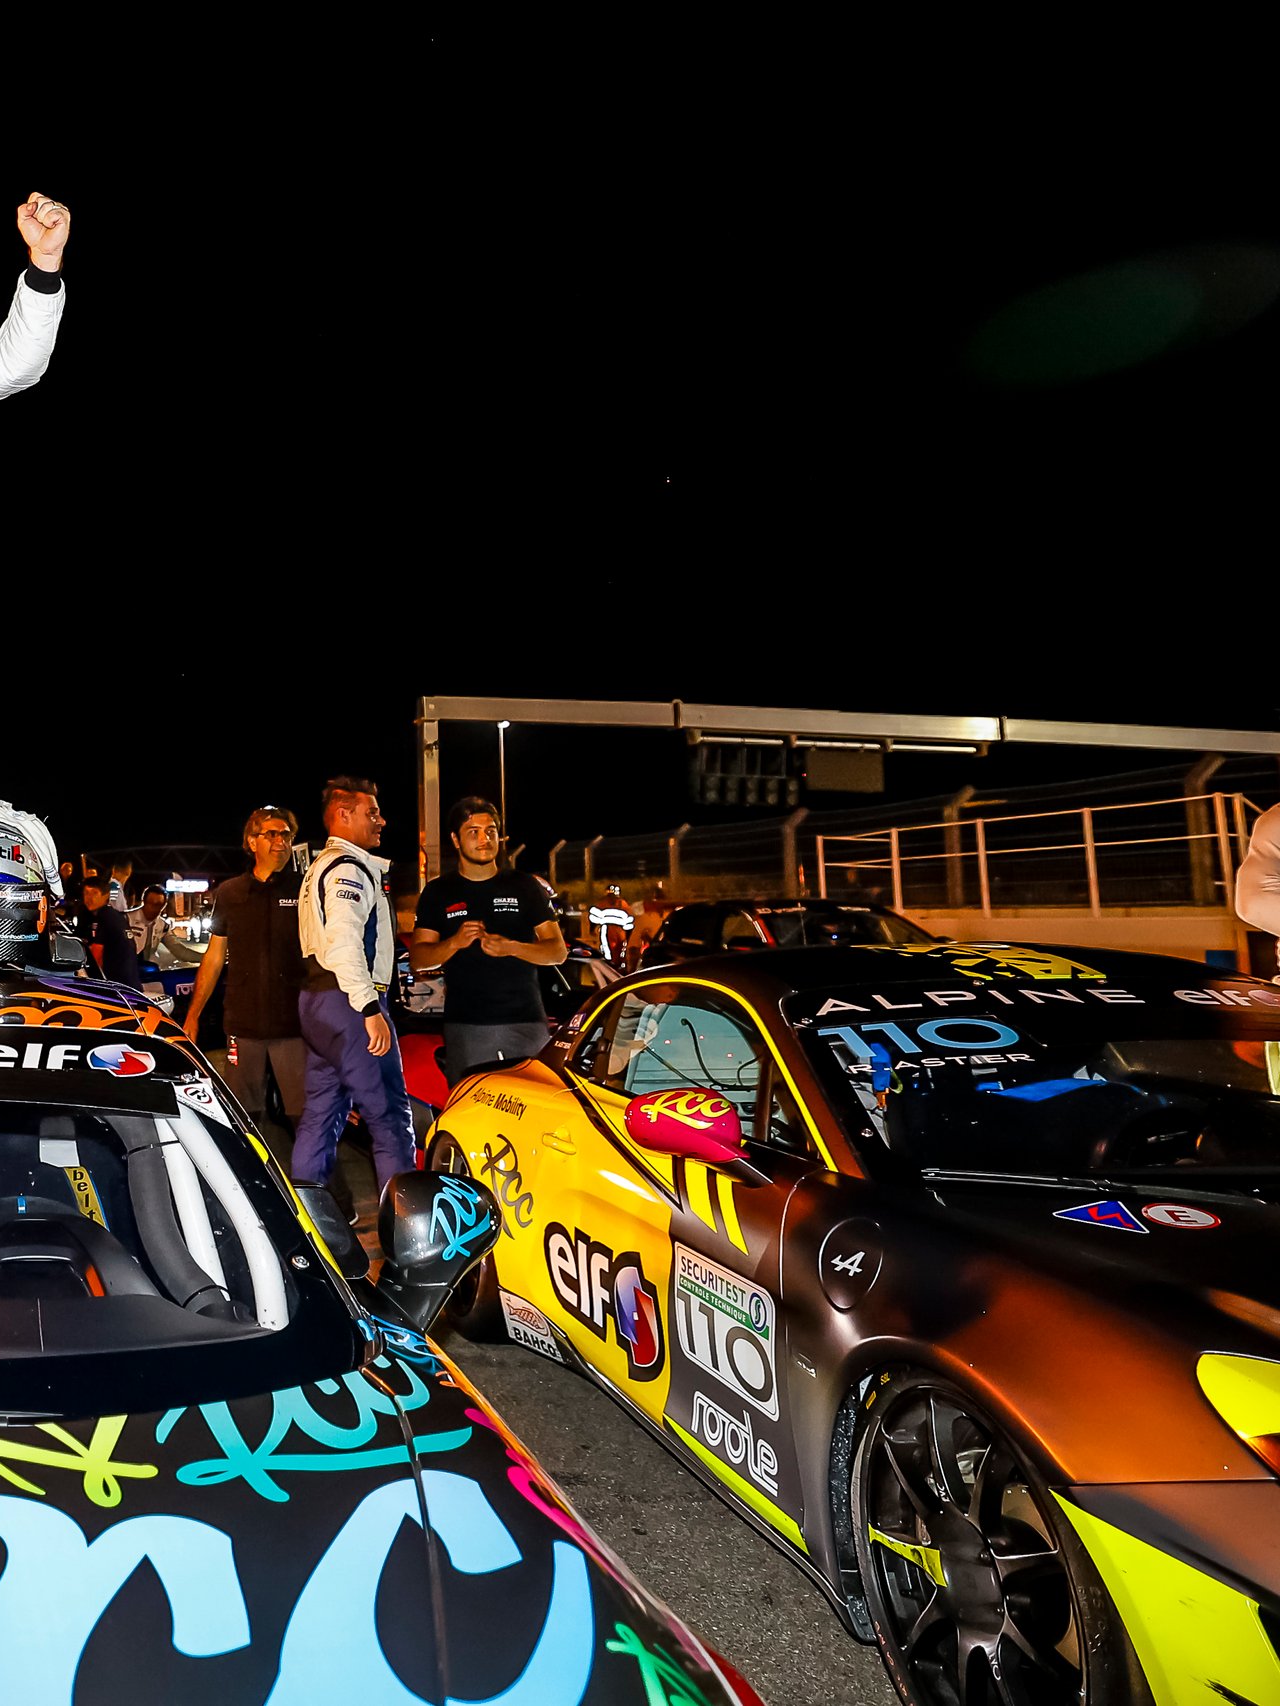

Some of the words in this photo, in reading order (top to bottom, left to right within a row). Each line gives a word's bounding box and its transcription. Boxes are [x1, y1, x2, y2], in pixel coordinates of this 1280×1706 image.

[816, 987, 1146, 1016] ALPINE
[1173, 988, 1253, 1006] elf
[818, 1017, 1020, 1058] 110
[470, 1087, 496, 1107] Alpine
[493, 1092, 528, 1121] Mobility
[548, 1232, 610, 1329] elf
[680, 1278, 710, 1301] CONTROLE
[711, 1294, 747, 1324] TECHNIQUE
[681, 1255, 747, 1308] SECURITEST
[512, 1326, 558, 1357] BAHCO
[677, 1288, 774, 1403] 110
